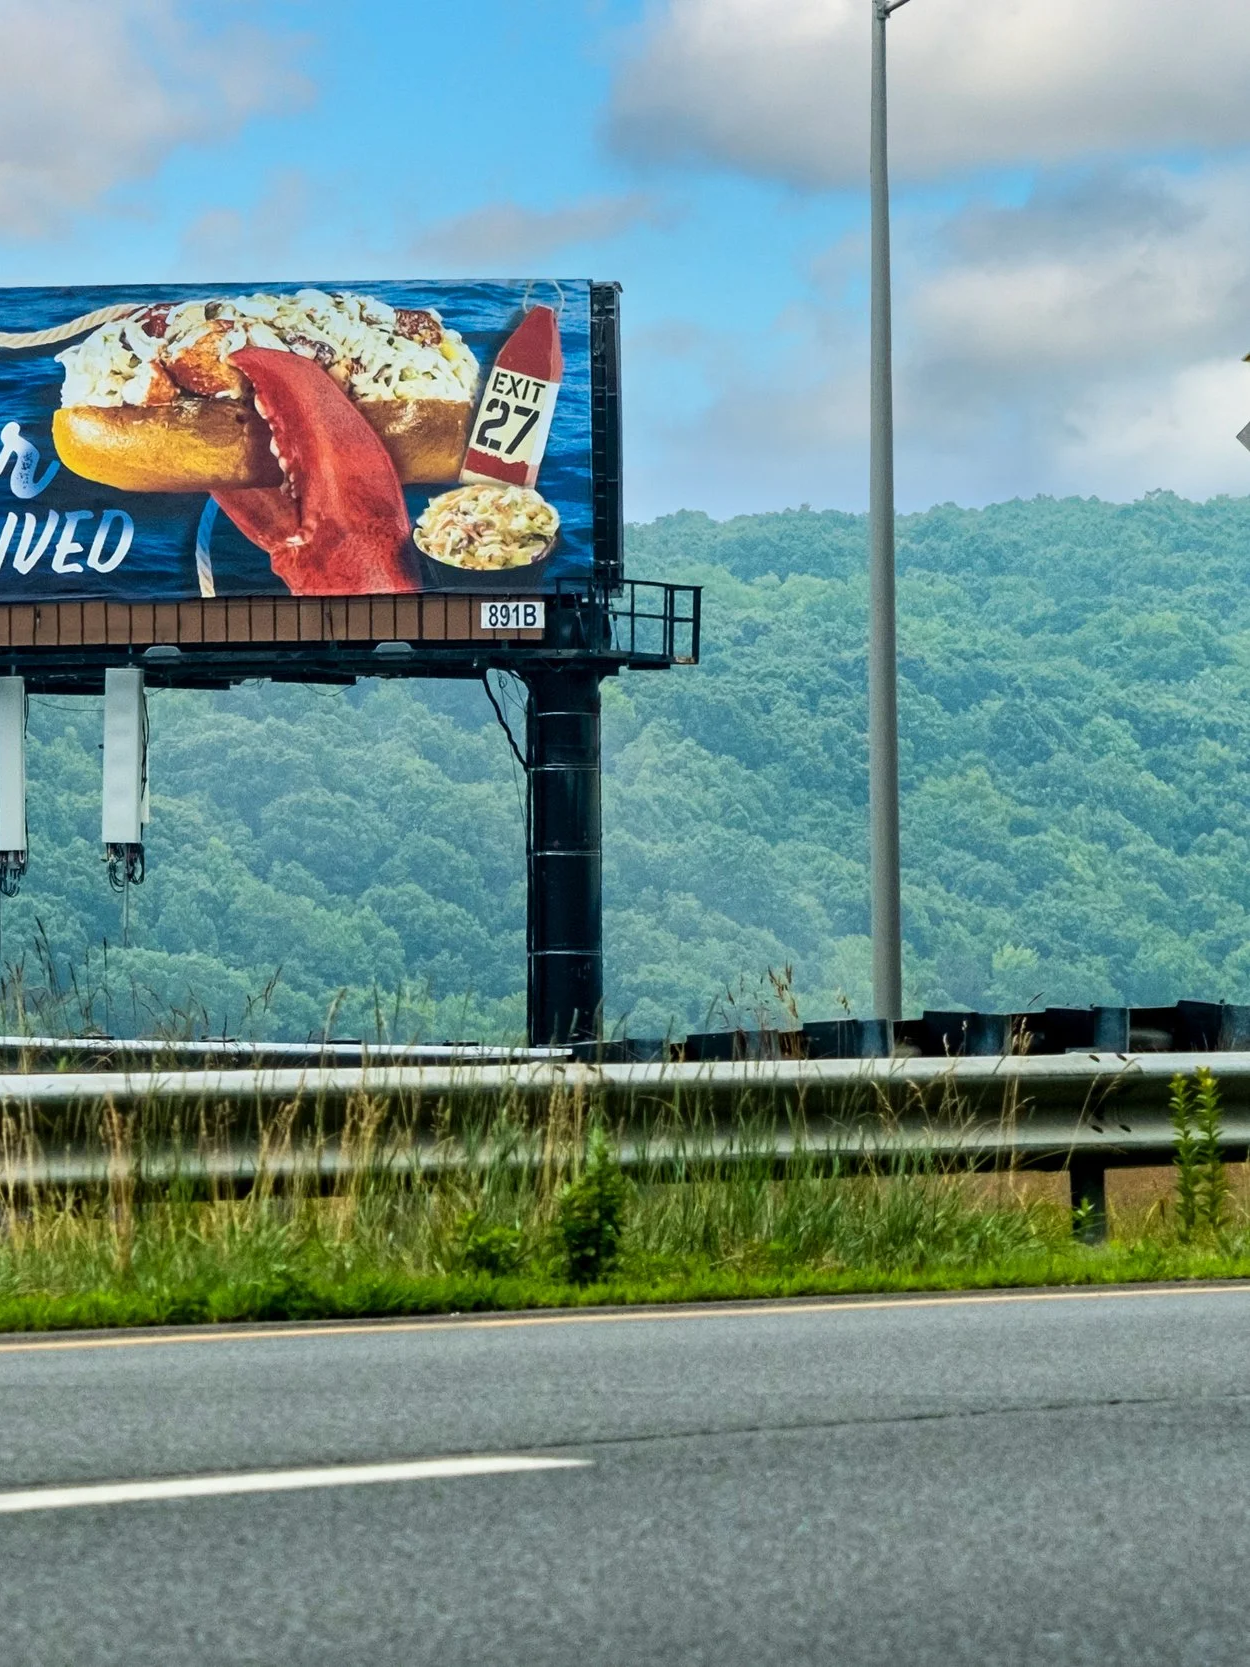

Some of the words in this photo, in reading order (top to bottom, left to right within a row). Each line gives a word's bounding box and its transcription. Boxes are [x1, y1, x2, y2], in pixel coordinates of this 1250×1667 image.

[491, 371, 546, 404] EXIT
[475, 397, 540, 455] 27
[488, 604, 537, 627] 891B
